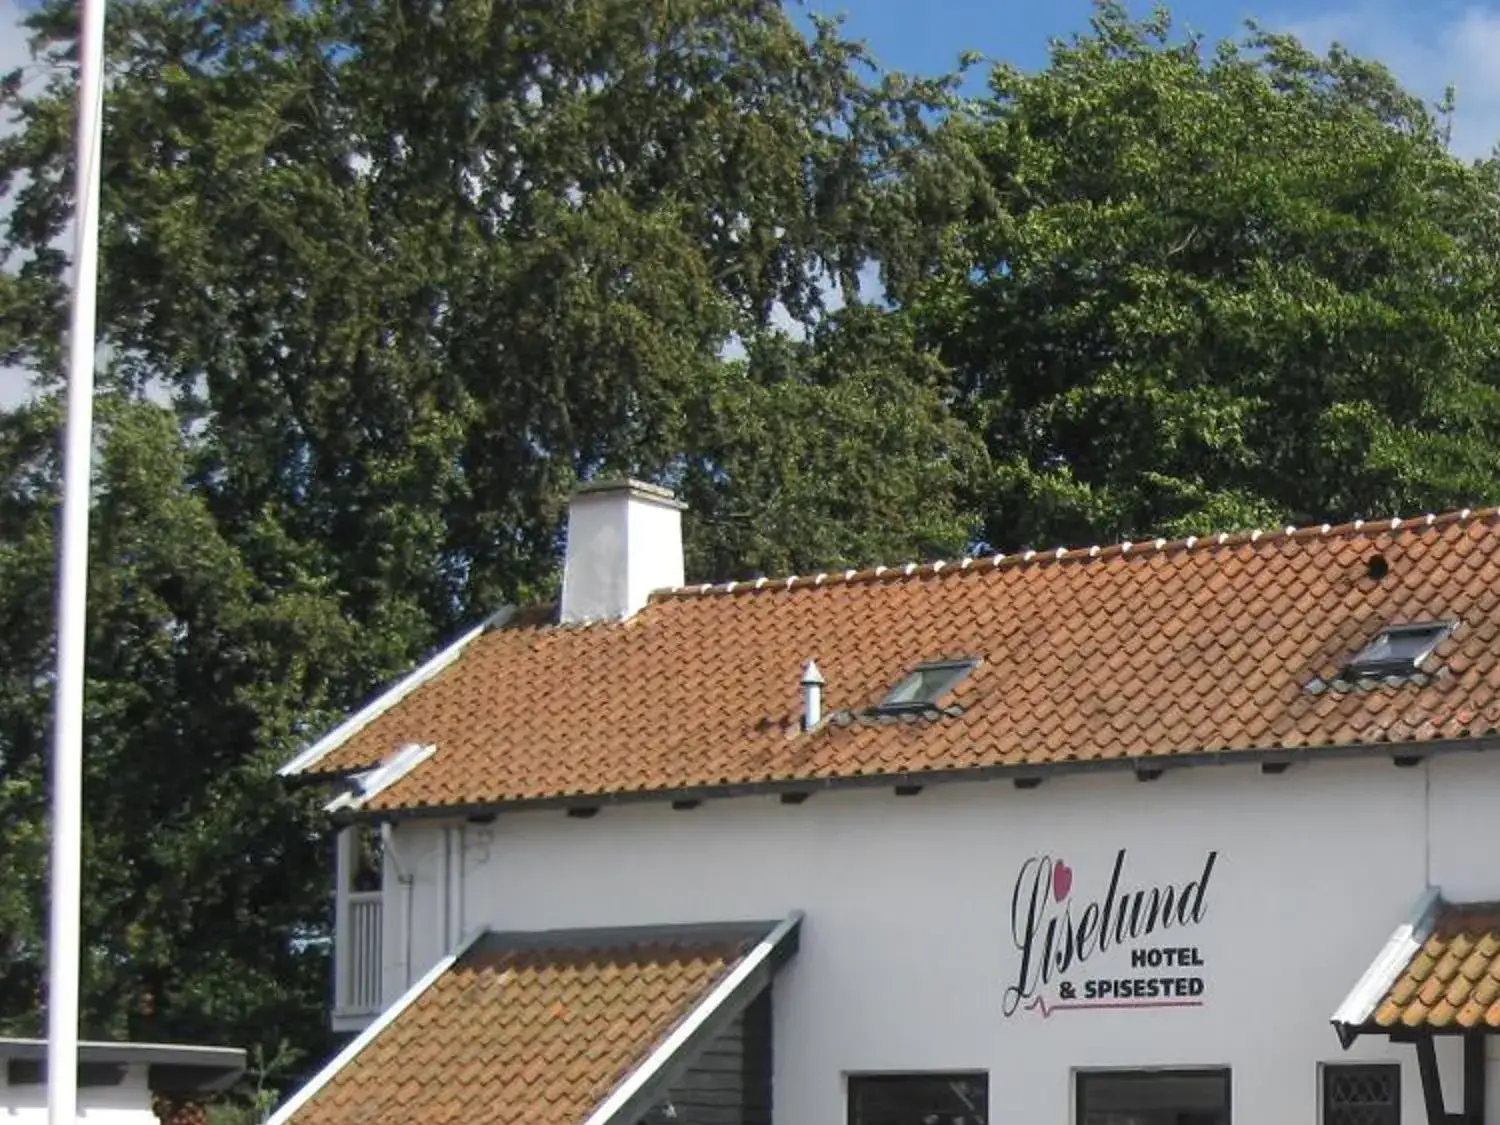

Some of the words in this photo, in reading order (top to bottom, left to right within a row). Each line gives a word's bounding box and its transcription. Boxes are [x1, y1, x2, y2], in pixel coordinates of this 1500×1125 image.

[1002, 848, 1217, 1017] Liselund
[1131, 948, 1204, 967] HOTEL
[1059, 982, 1076, 998] &
[1085, 978, 1204, 998] SPISESTED
